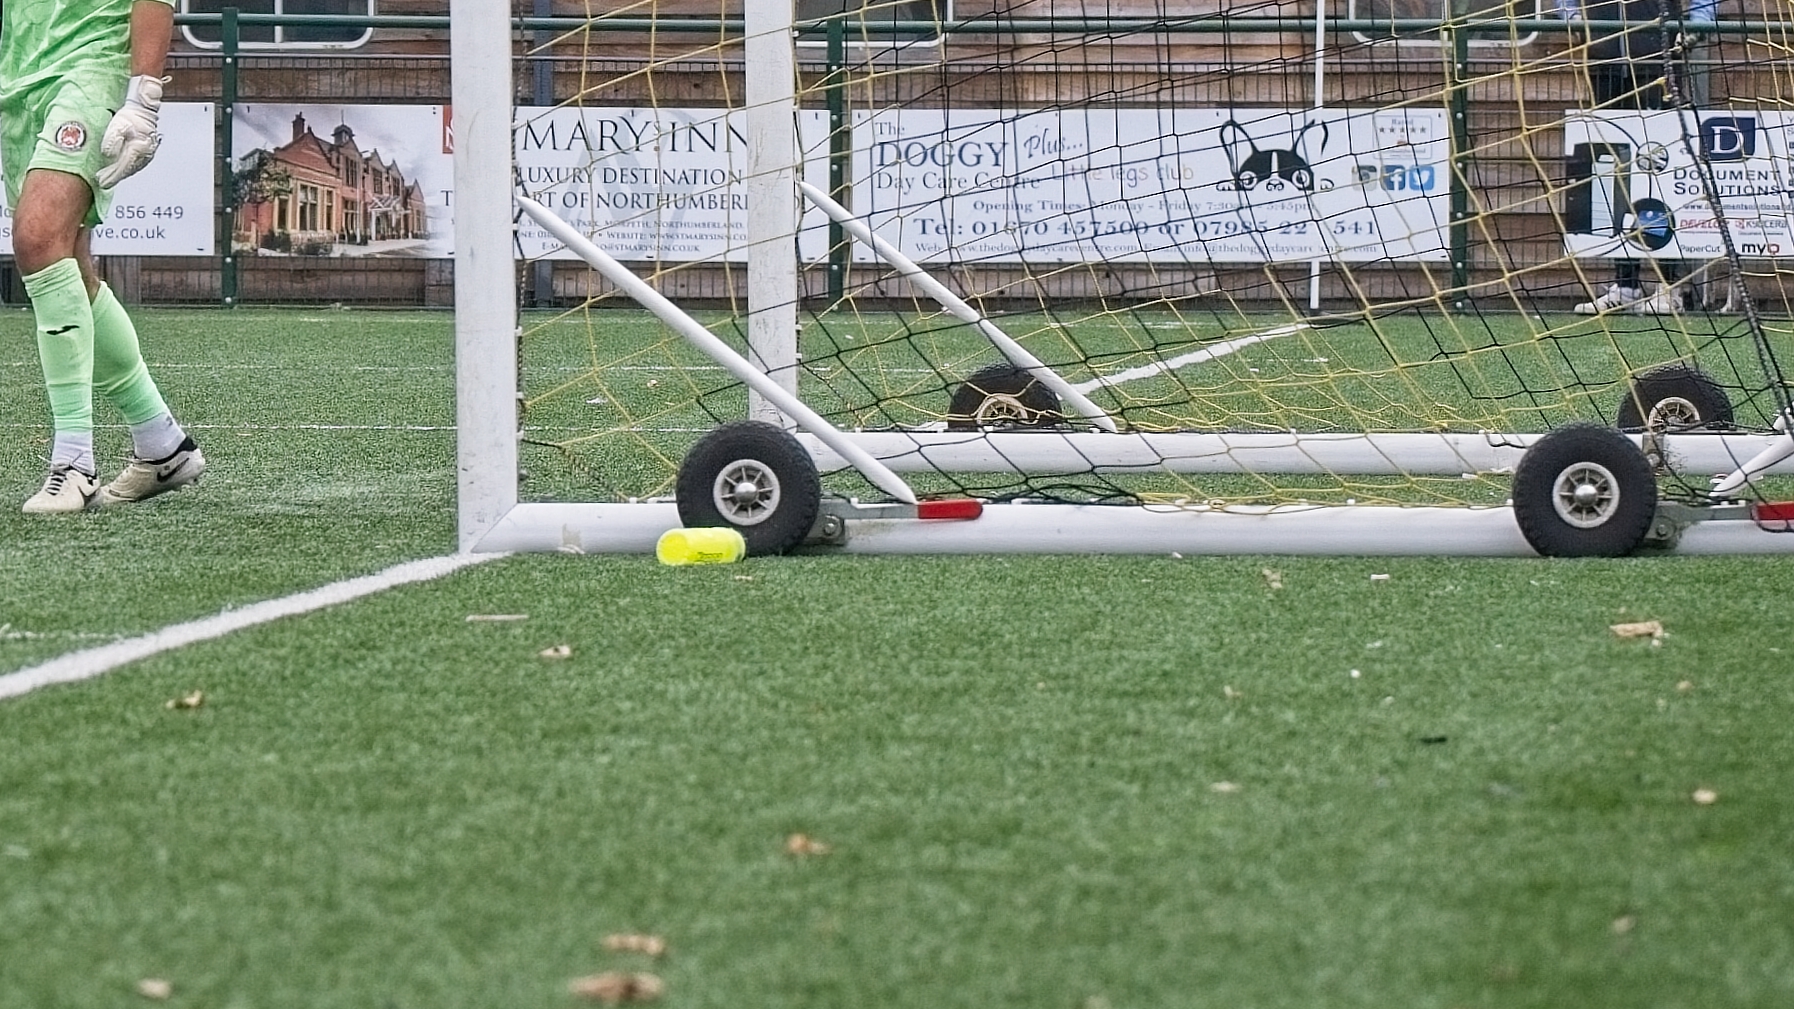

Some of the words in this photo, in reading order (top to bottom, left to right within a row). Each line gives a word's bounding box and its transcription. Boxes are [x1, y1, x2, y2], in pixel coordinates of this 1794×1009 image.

[669, 121, 748, 153] INN
[875, 121, 906, 136] The
[1710, 125, 1745, 154] D
[876, 141, 1009, 168] DOGGY
[518, 167, 596, 184] LUXURY
[603, 167, 742, 187] DESTINATION
[877, 171, 915, 195] Day
[923, 171, 967, 189] Care
[974, 171, 1040, 190] Centre
[1110, 163, 1149, 188] legs
[1156, 163, 1195, 181] club
[562, 191, 589, 208] OF
[973, 200, 1033, 212] Opening
[1159, 200, 1202, 212] Friday
[115, 205, 146, 219] 856
[152, 206, 184, 219] 449
[913, 218, 963, 235] Tel:
[972, 220, 1048, 235] 01670
[1057, 220, 1149, 235] 457500
[1158, 222, 1185, 235] or
[1333, 221, 1375, 235] 541
